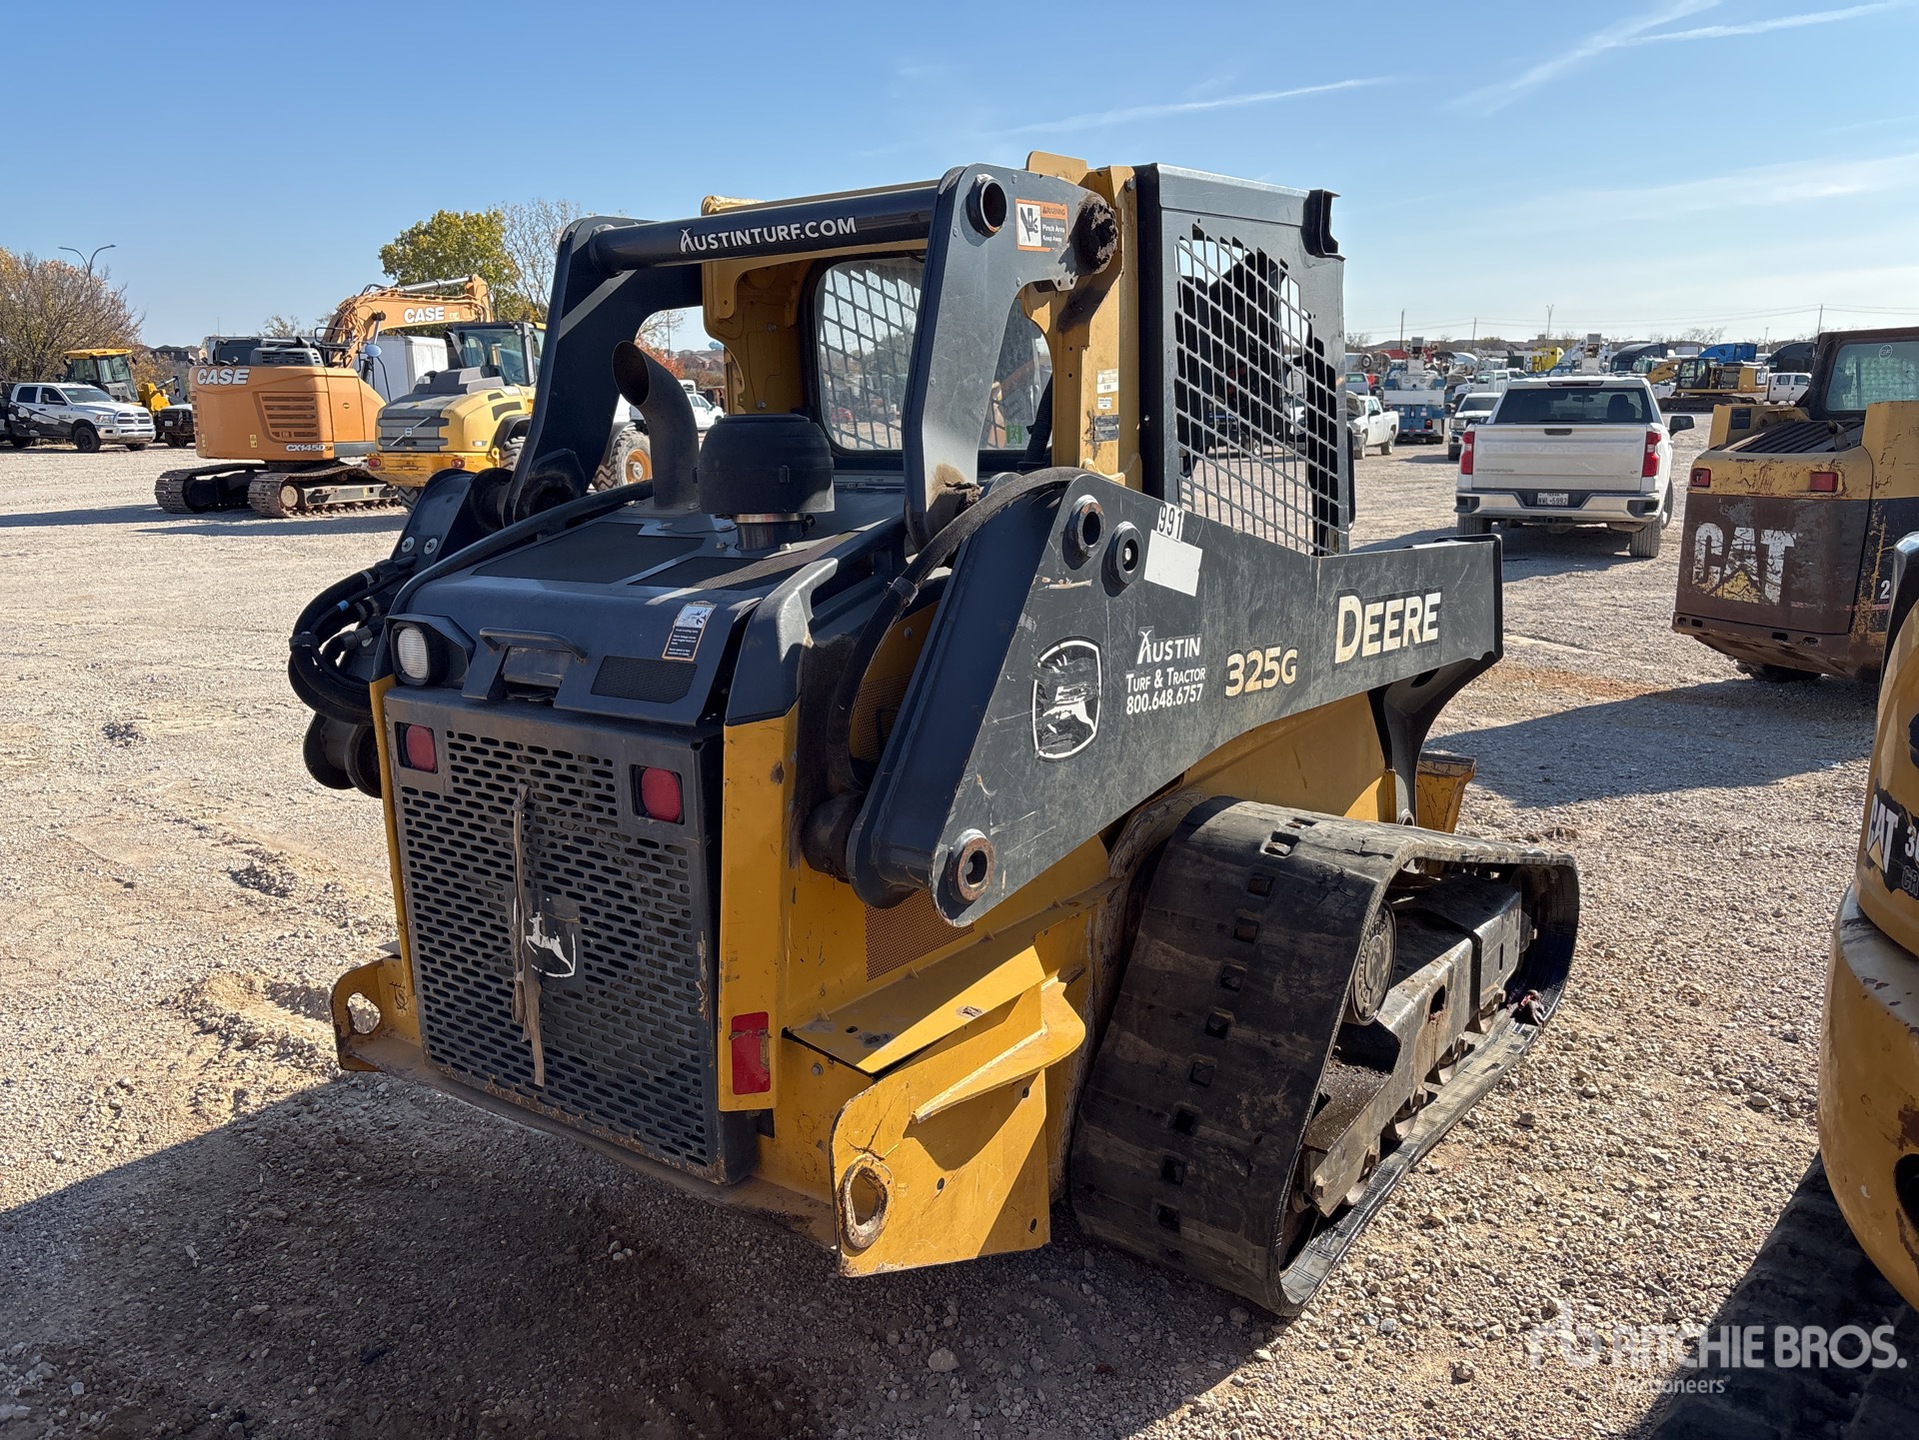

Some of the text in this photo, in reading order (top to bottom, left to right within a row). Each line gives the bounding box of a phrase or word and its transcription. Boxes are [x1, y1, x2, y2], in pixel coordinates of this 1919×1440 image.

[680, 217, 858, 253] AUSTINTURF.COM
[404, 306, 445, 324] CASE
[197, 368, 250, 386] CASE
[1757, 371, 1767, 384] CAT
[1159, 503, 1183, 540] 991
[1692, 522, 1797, 607] CAT
[1335, 592, 1442, 664] DEERE
[1137, 630, 1200, 665] AUSTIN
[1126, 667, 1206, 693] TURF & TRACTOR
[1225, 646, 1298, 698] 325G
[1126, 683, 1203, 715] 800.648.6757
[1866, 794, 1899, 874] CAT
